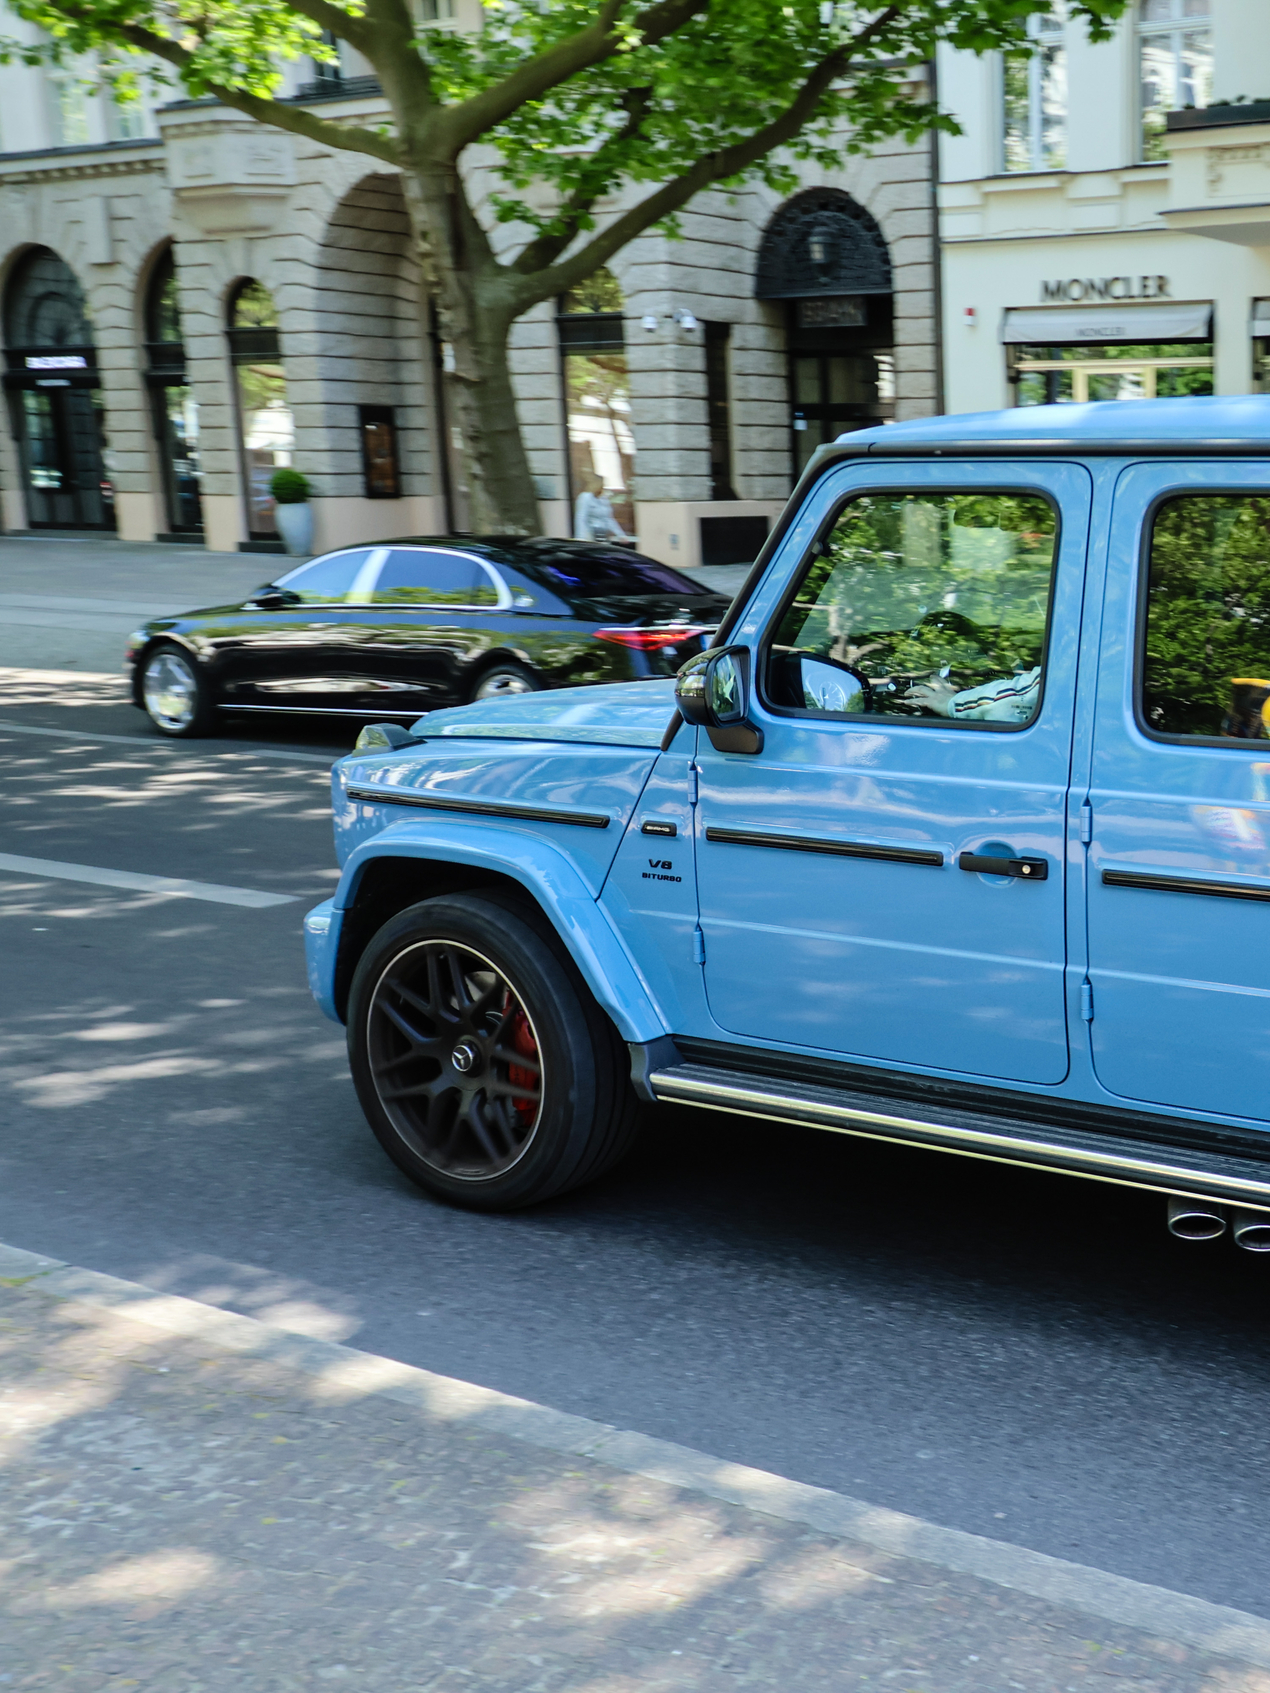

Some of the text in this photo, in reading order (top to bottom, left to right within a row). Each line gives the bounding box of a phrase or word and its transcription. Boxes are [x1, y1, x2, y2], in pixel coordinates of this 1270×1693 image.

[1040, 275, 1172, 302] MONCLER
[648, 859, 673, 870] V8
[641, 872, 682, 883] BITURBO
